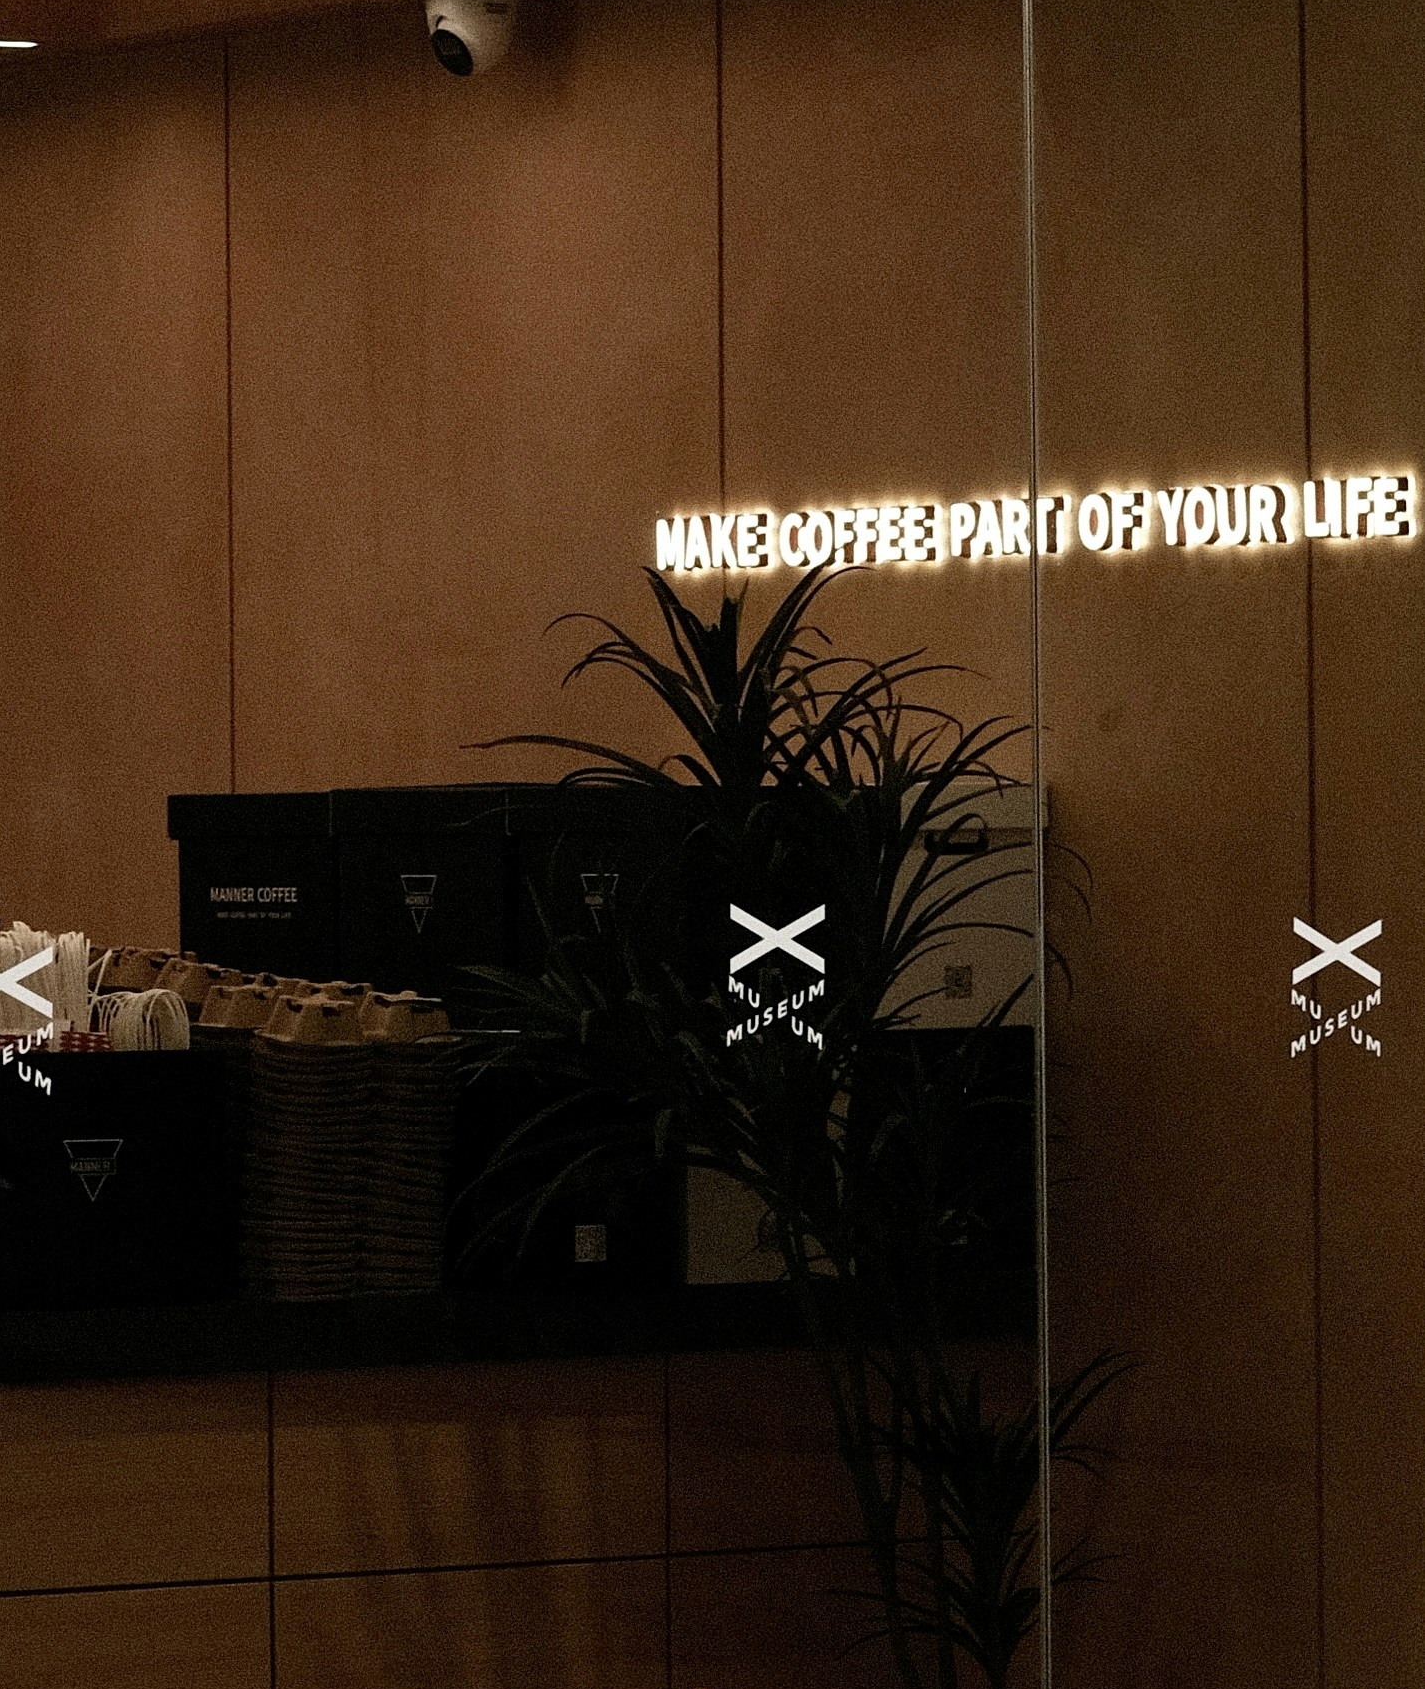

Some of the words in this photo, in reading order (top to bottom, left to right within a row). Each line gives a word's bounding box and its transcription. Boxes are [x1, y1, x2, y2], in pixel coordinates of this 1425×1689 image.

[656, 512, 771, 571] MAKE
[779, 505, 938, 569] COFFEE
[950, 495, 1066, 558] PART
[1078, 491, 1148, 551] OF
[1157, 484, 1292, 547] YOUR
[1304, 475, 1415, 539] LIFE
[210, 886, 255, 903] MANNER
[256, 886, 298, 903] COFFEE
